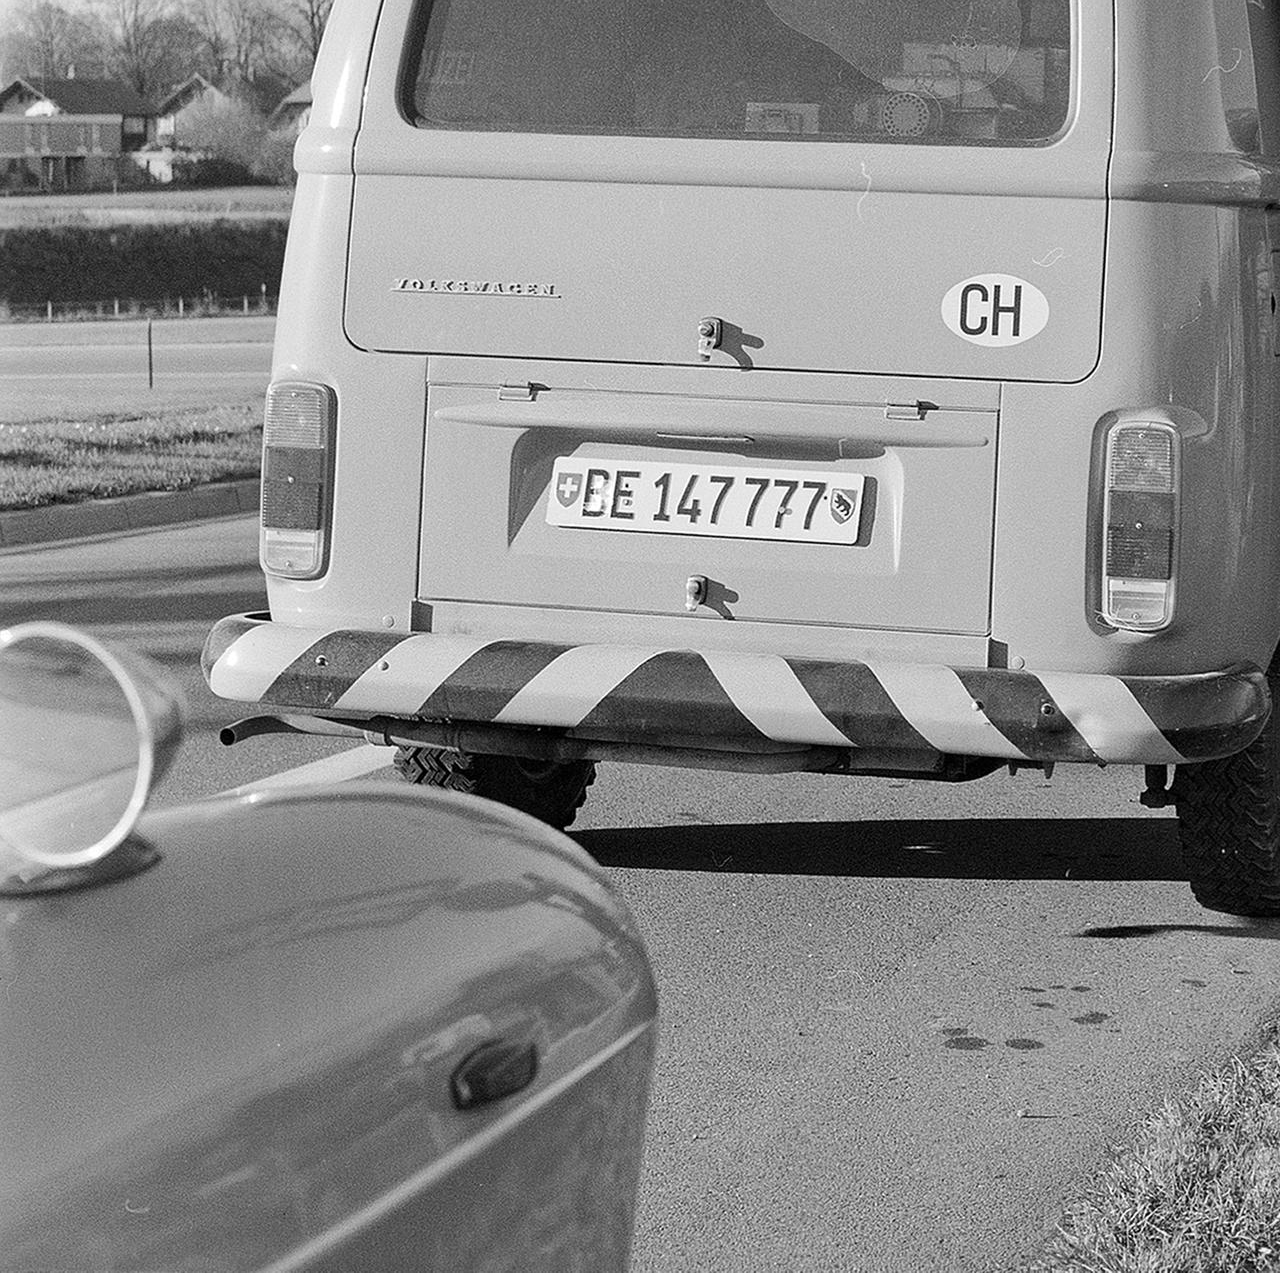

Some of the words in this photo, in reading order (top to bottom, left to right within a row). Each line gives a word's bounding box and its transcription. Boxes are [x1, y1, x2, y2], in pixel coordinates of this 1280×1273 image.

[394, 278, 556, 296] VOLKSWAGEN
[959, 283, 1022, 337] CH
[581, 468, 642, 520] BE
[652, 472, 735, 525] 147
[744, 476, 828, 531] 777
